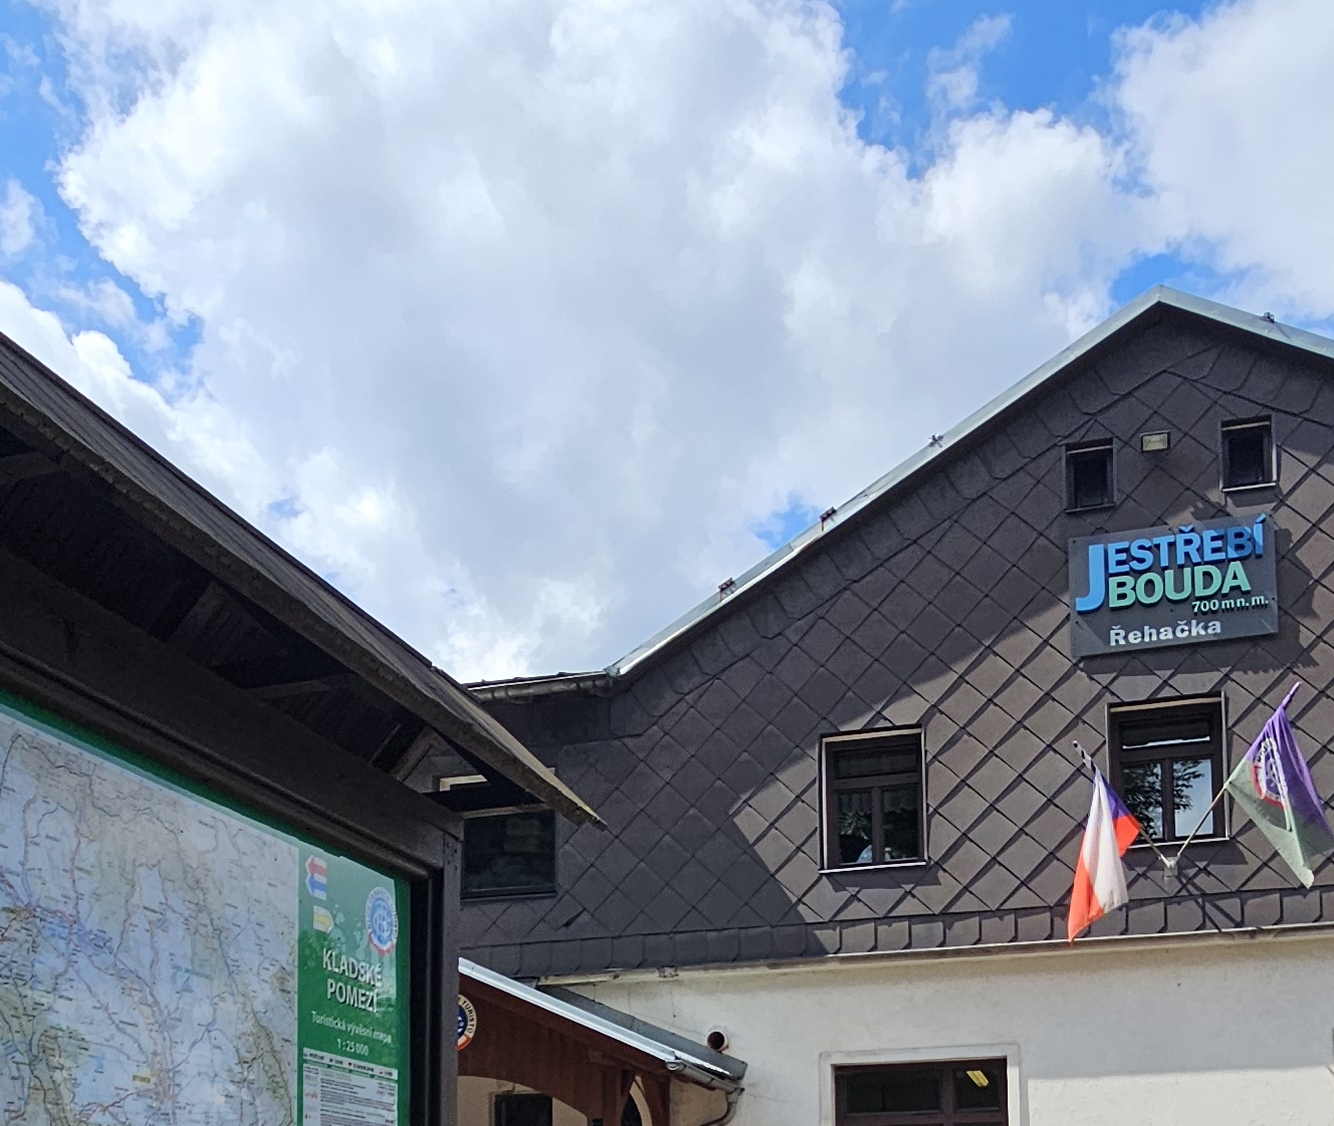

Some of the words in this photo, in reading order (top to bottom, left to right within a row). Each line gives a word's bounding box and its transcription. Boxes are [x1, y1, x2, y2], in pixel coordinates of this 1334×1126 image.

[1076, 513, 1267, 614] JESTŘEBÍ
[1108, 560, 1252, 609] BOUDA
[1192, 599, 1218, 613] 700
[1109, 619, 1222, 647] Řehačka
[322, 946, 382, 988] KLADSKÉ
[327, 978, 378, 1013] POMEZÍ
